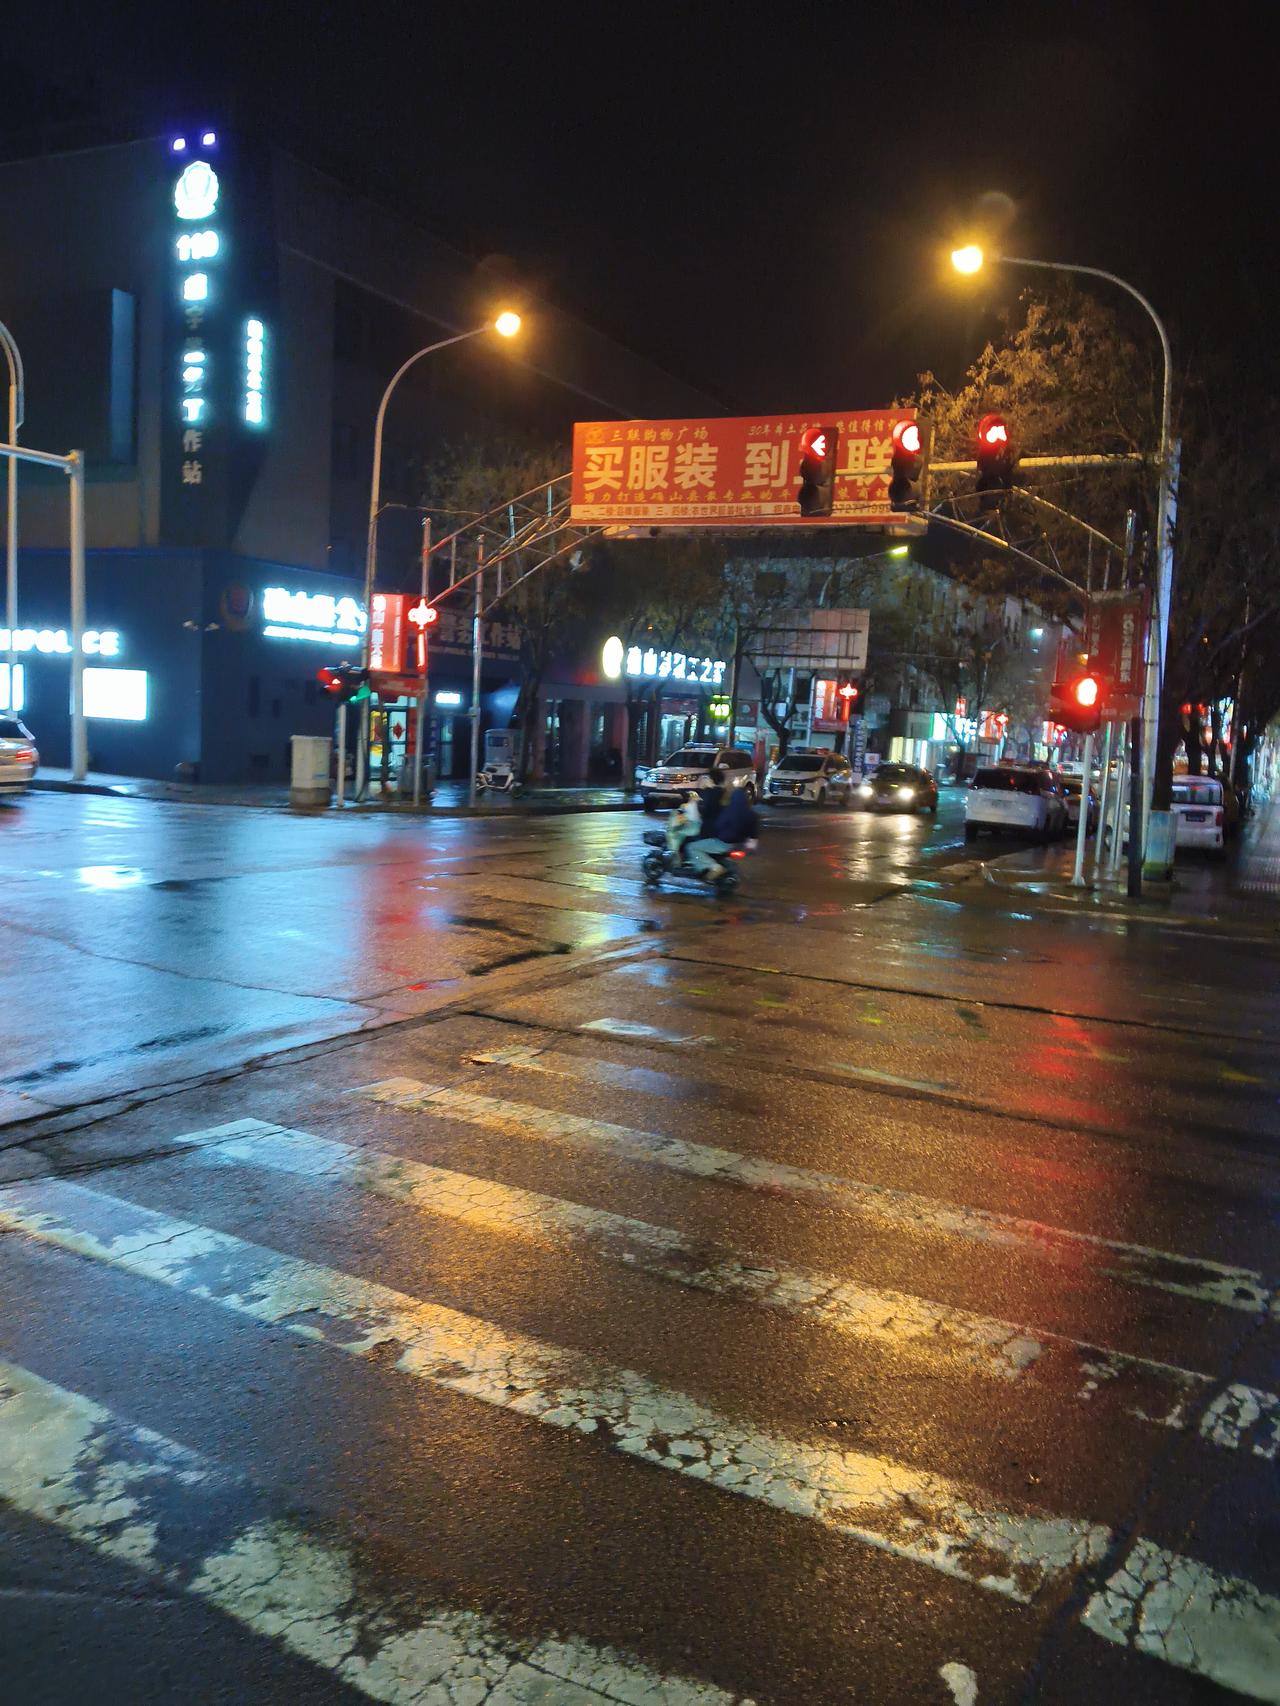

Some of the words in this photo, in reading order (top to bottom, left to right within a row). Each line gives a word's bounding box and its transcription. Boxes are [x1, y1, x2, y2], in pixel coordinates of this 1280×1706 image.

[583, 442, 718, 491] 买服装
[743, 436, 893, 487] 到联
[17, 629, 119, 656] POLCE
